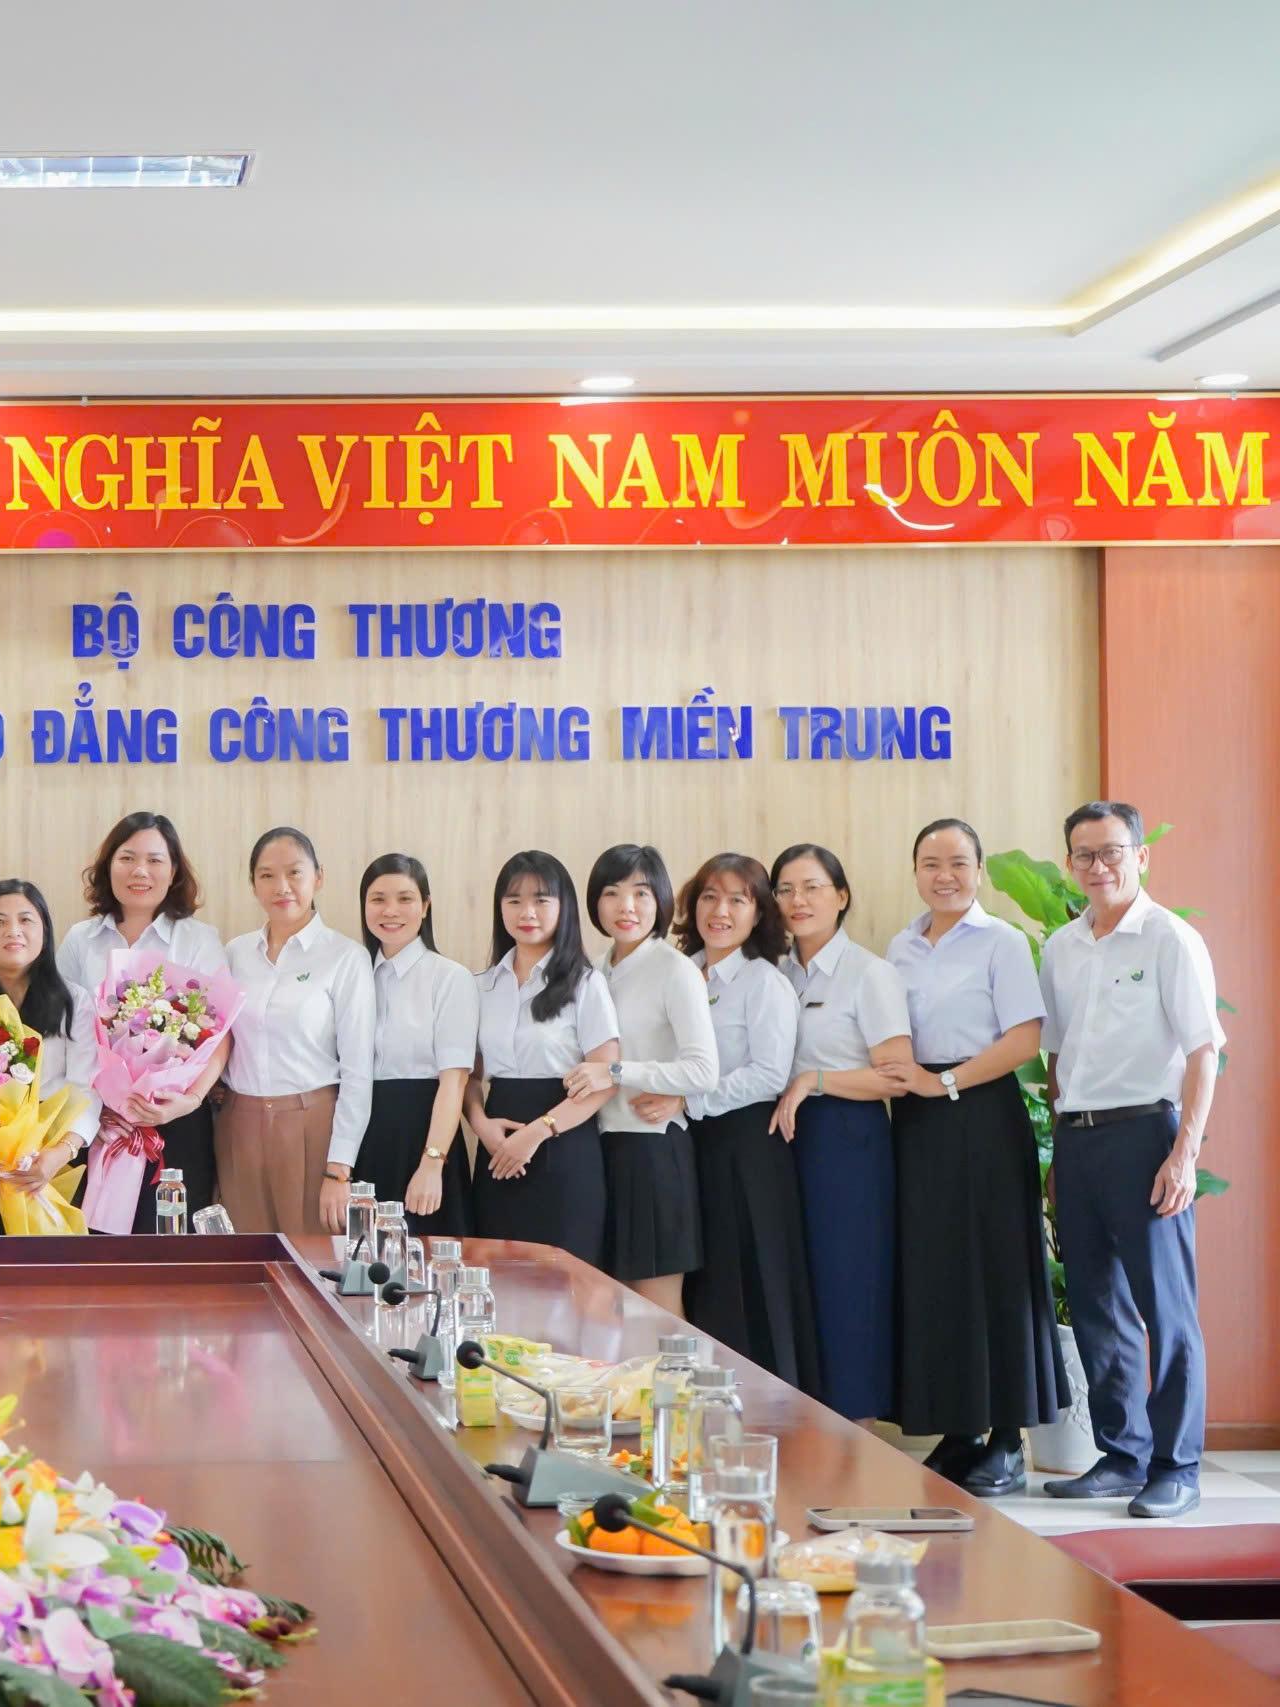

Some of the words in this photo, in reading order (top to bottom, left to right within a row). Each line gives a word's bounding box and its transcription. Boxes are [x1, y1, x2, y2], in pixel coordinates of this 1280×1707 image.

[5, 416, 284, 511] NGHĨA
[298, 412, 513, 525] VIỆT
[548, 433, 747, 509] NAM
[780, 409, 1041, 508] MUÔN
[1073, 411, 1271, 507] NĂM
[72, 592, 140, 669] BỘ
[173, 592, 316, 660] CÔNG
[348, 596, 562, 660] THƯƠNG
[31, 682, 179, 764] ĐẲNG
[209, 696, 350, 763] CÔNG
[379, 701, 591, 762] THƯƠNG
[622, 686, 753, 760] MIỀN
[778, 705, 952, 761] TRUNG
